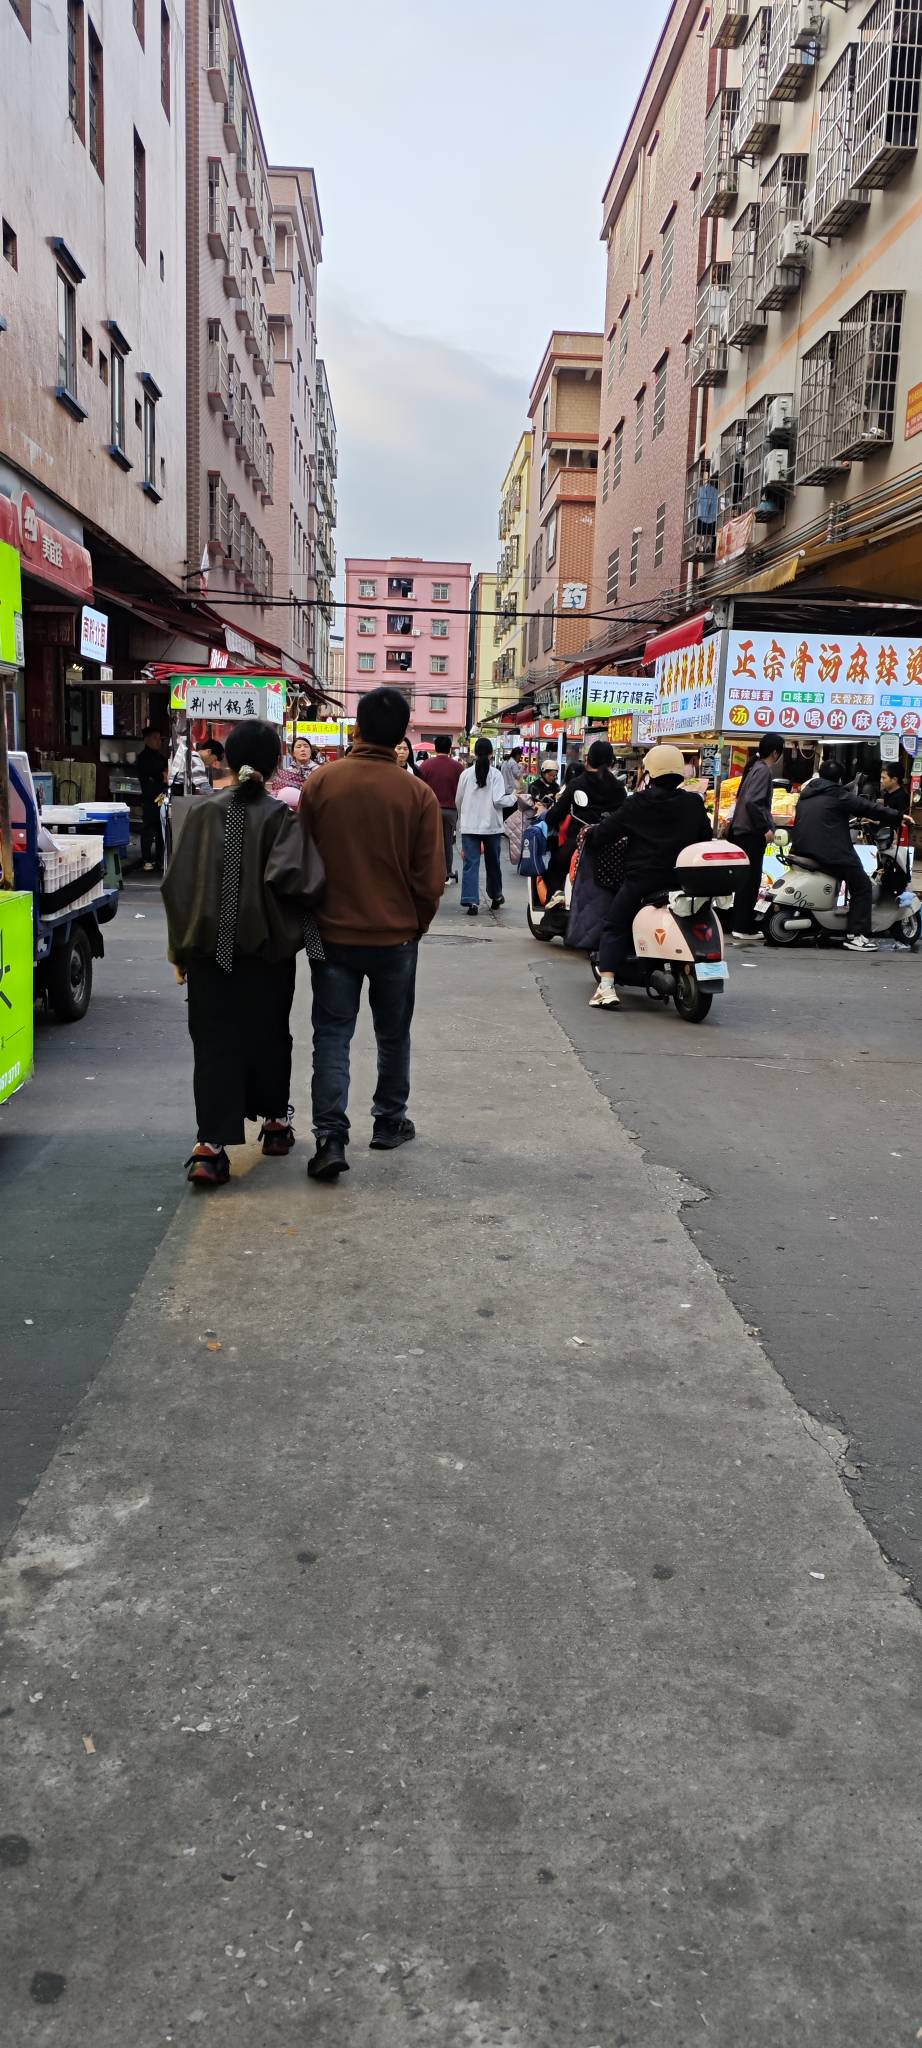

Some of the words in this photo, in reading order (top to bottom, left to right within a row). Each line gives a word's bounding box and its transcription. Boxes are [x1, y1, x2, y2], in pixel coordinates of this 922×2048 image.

[42, 534, 63, 569] 美宜佳
[562, 583, 588, 609] 药
[589, 688, 654, 705] 手打柠檬茶
[730, 689, 772, 701] 麻辣鲜香
[783, 692, 824, 704] 口味丰富
[831, 693, 873, 705] 大骨浓汤
[190, 696, 257, 716] 荆州锅盔
[731, 706, 919, 732] 汤可以喝的麻辣烫
